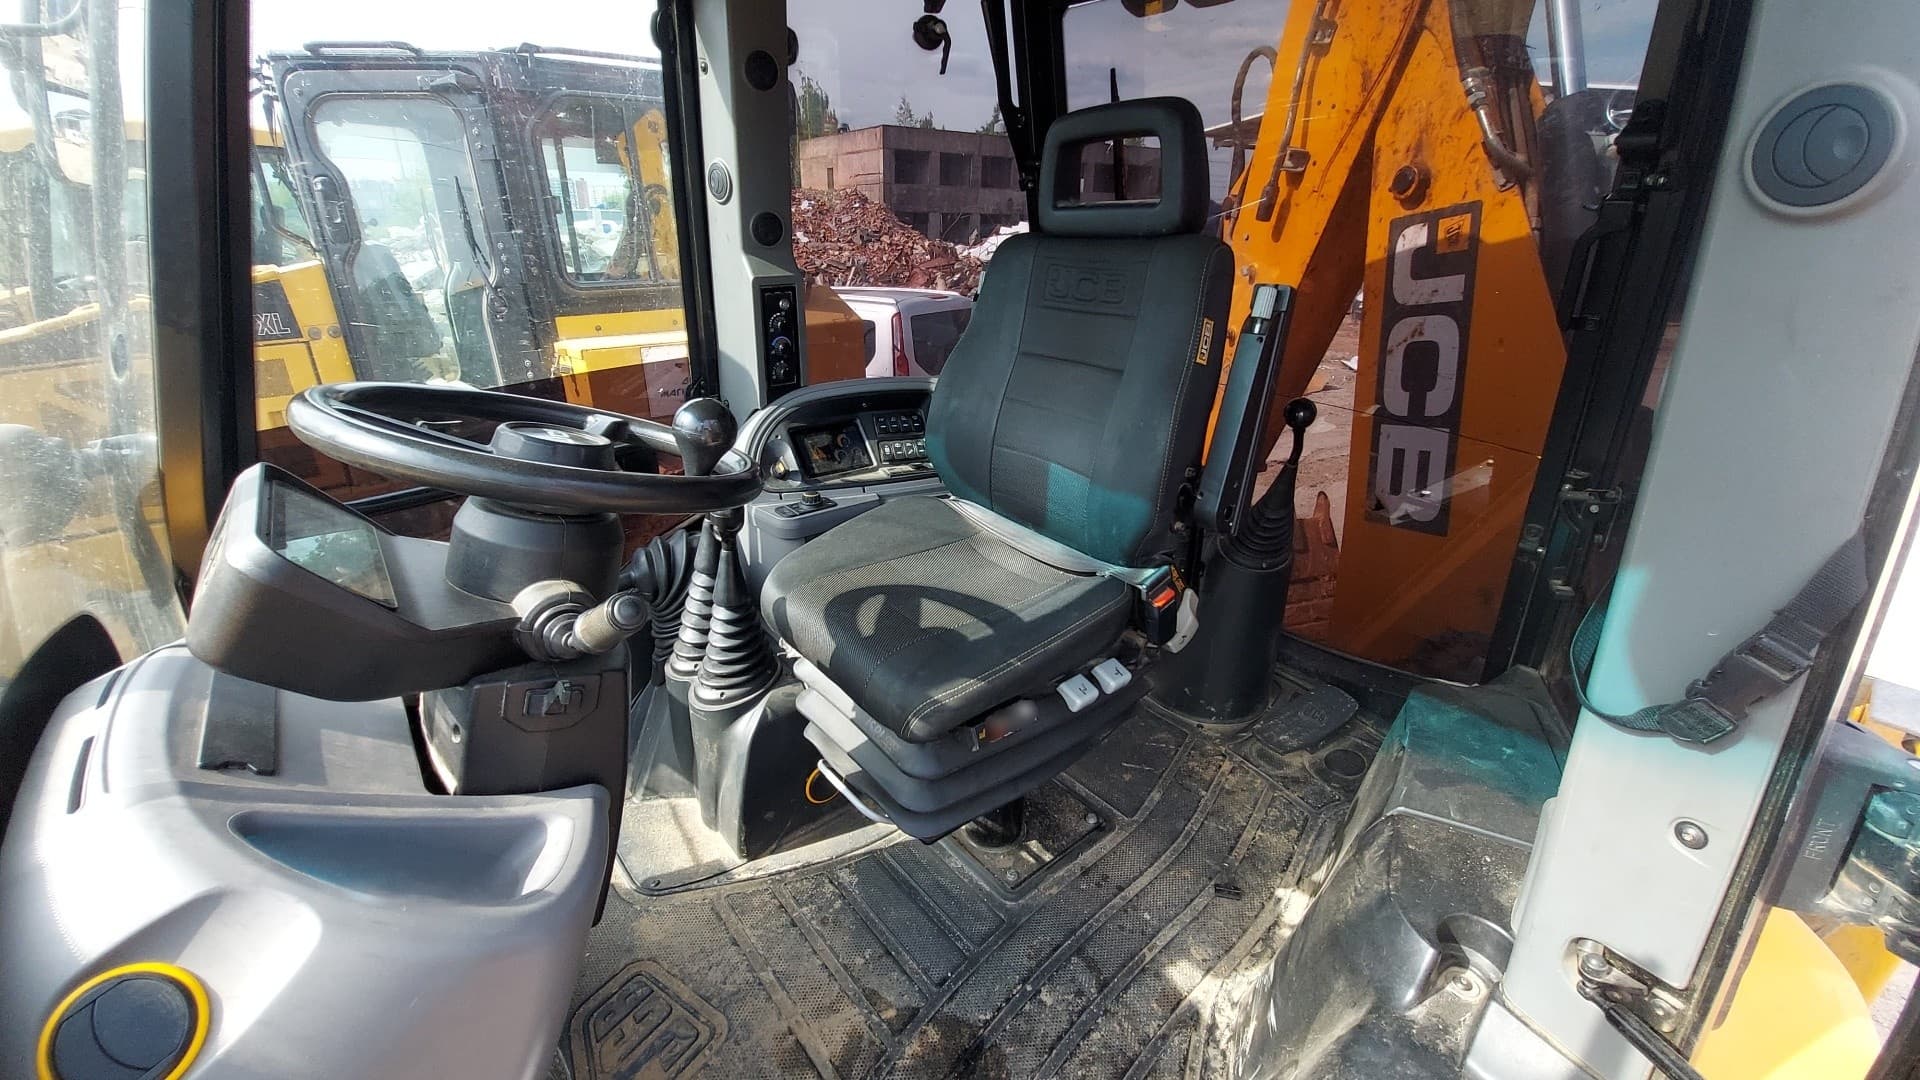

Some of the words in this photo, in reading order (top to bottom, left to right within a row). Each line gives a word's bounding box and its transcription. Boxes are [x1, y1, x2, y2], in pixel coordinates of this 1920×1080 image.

[1046, 266, 1127, 304] JCB
[254, 312, 291, 336] XL
[1197, 320, 1213, 363] JCB
[1375, 222, 1466, 525] JCB
[1803, 820, 1837, 860] FRONT
